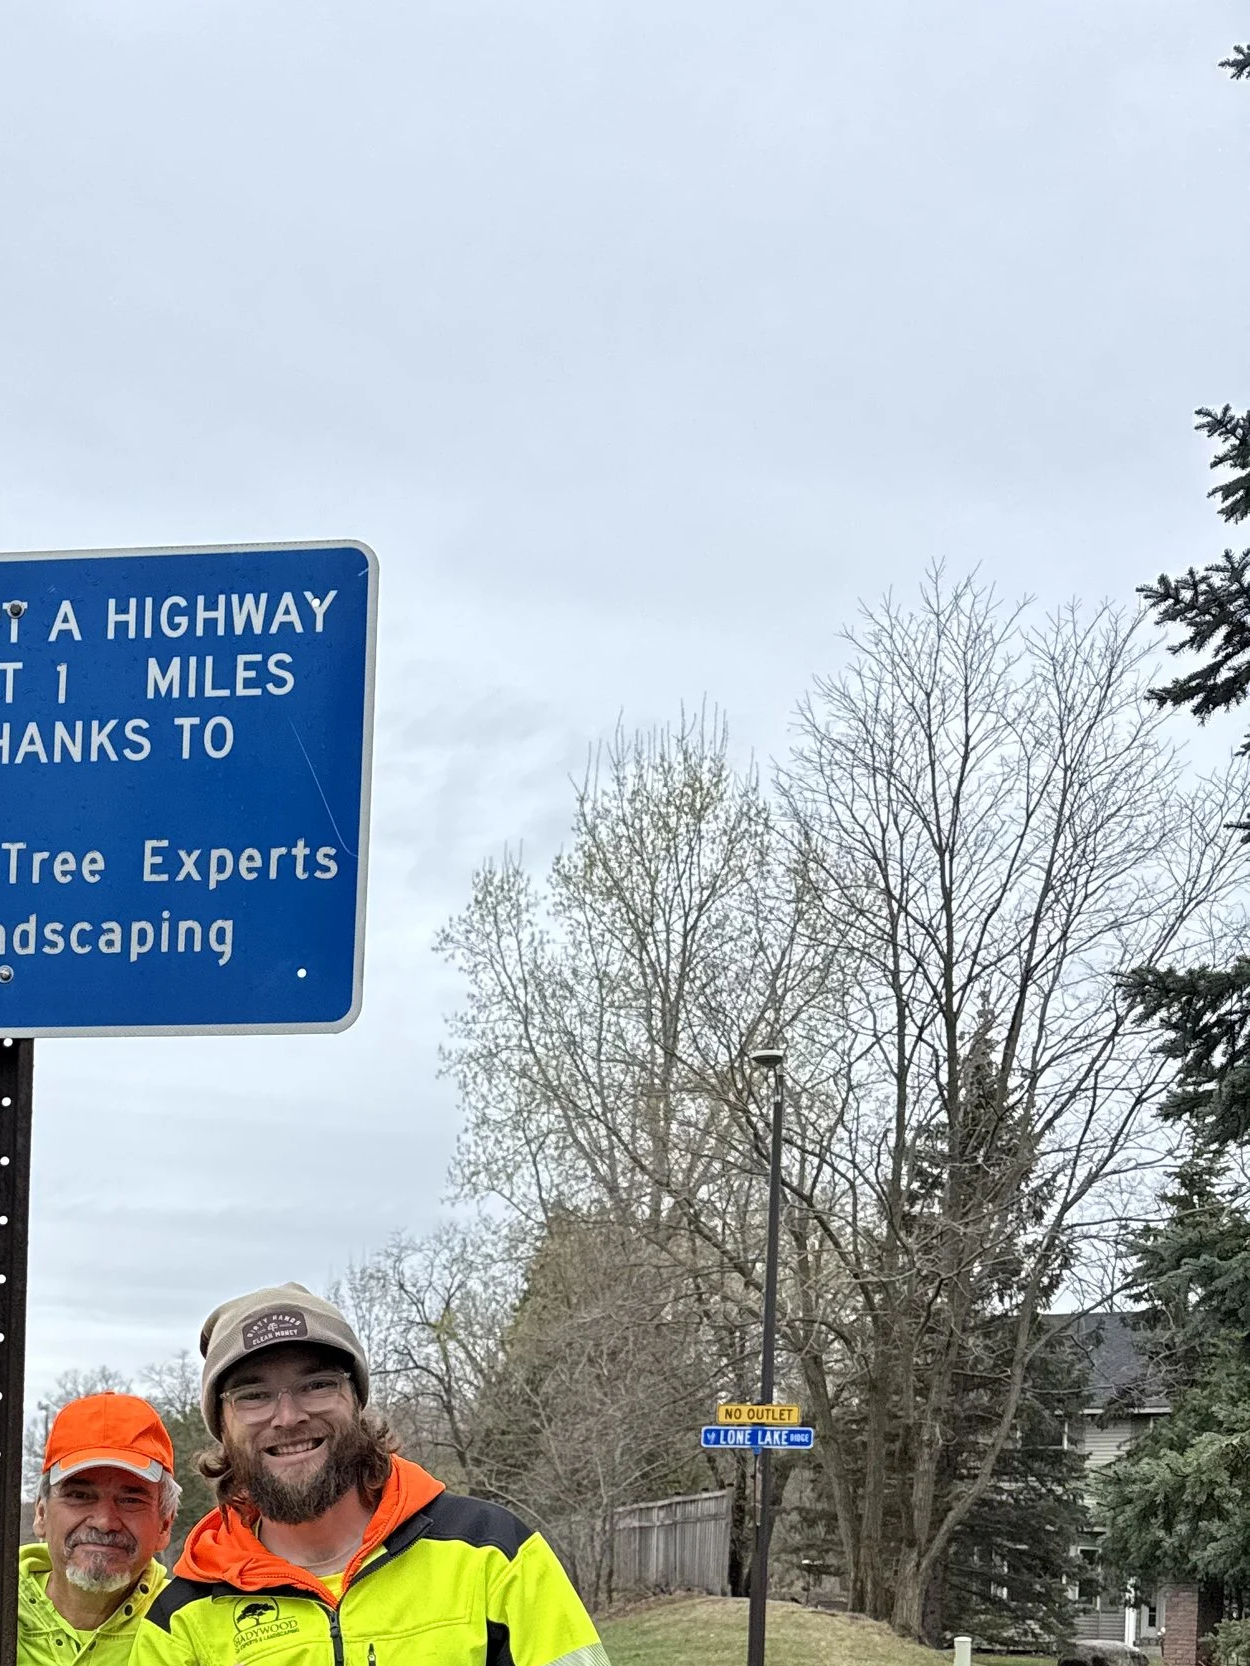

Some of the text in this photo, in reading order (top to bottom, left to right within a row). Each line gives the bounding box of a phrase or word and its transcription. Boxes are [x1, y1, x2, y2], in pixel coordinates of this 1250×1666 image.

[49, 600, 82, 642] A
[107, 590, 338, 640] HIGHWAY
[56, 663, 68, 704] 1
[146, 652, 295, 699] MILES
[174, 716, 234, 759] TO
[1, 842, 105, 884] Tree
[143, 838, 338, 890] Experts
[719, 1430, 753, 1445] LONE
[757, 1430, 789, 1445] LAKE
[724, 1408, 794, 1421] NO OUTLET
